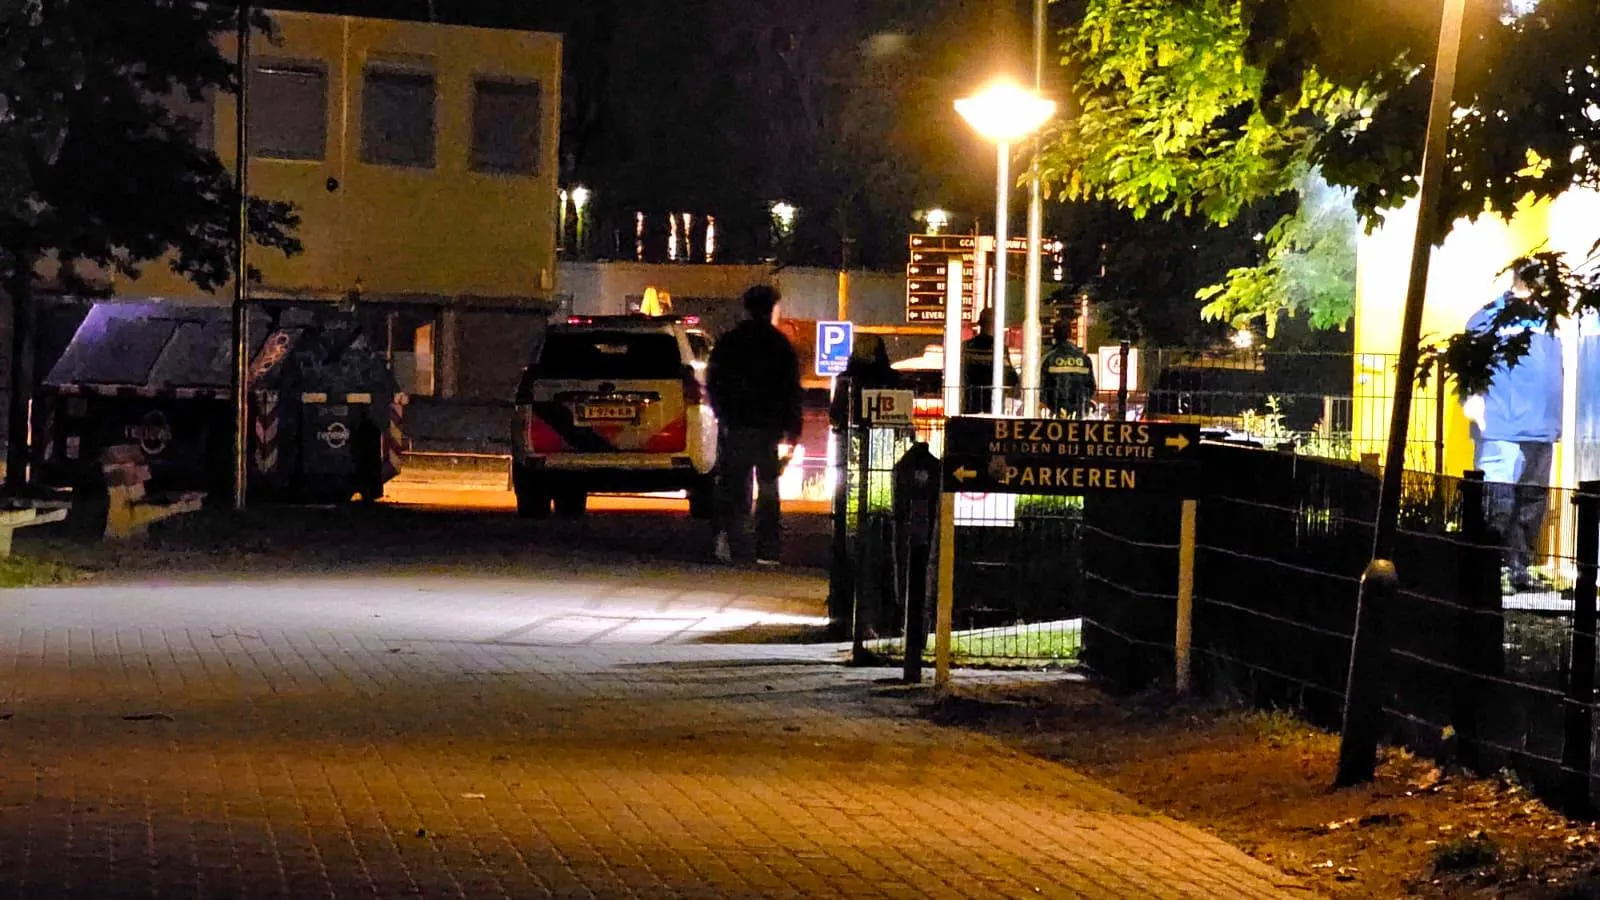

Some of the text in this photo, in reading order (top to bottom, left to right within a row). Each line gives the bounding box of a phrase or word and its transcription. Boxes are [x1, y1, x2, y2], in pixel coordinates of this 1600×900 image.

[824, 326, 845, 355] P
[995, 420, 1150, 444] BEZOEKERS
[1058, 444, 1079, 456] BIJ
[1087, 445, 1154, 458] RECEPTIE
[1005, 467, 1136, 489] PARKEREN
